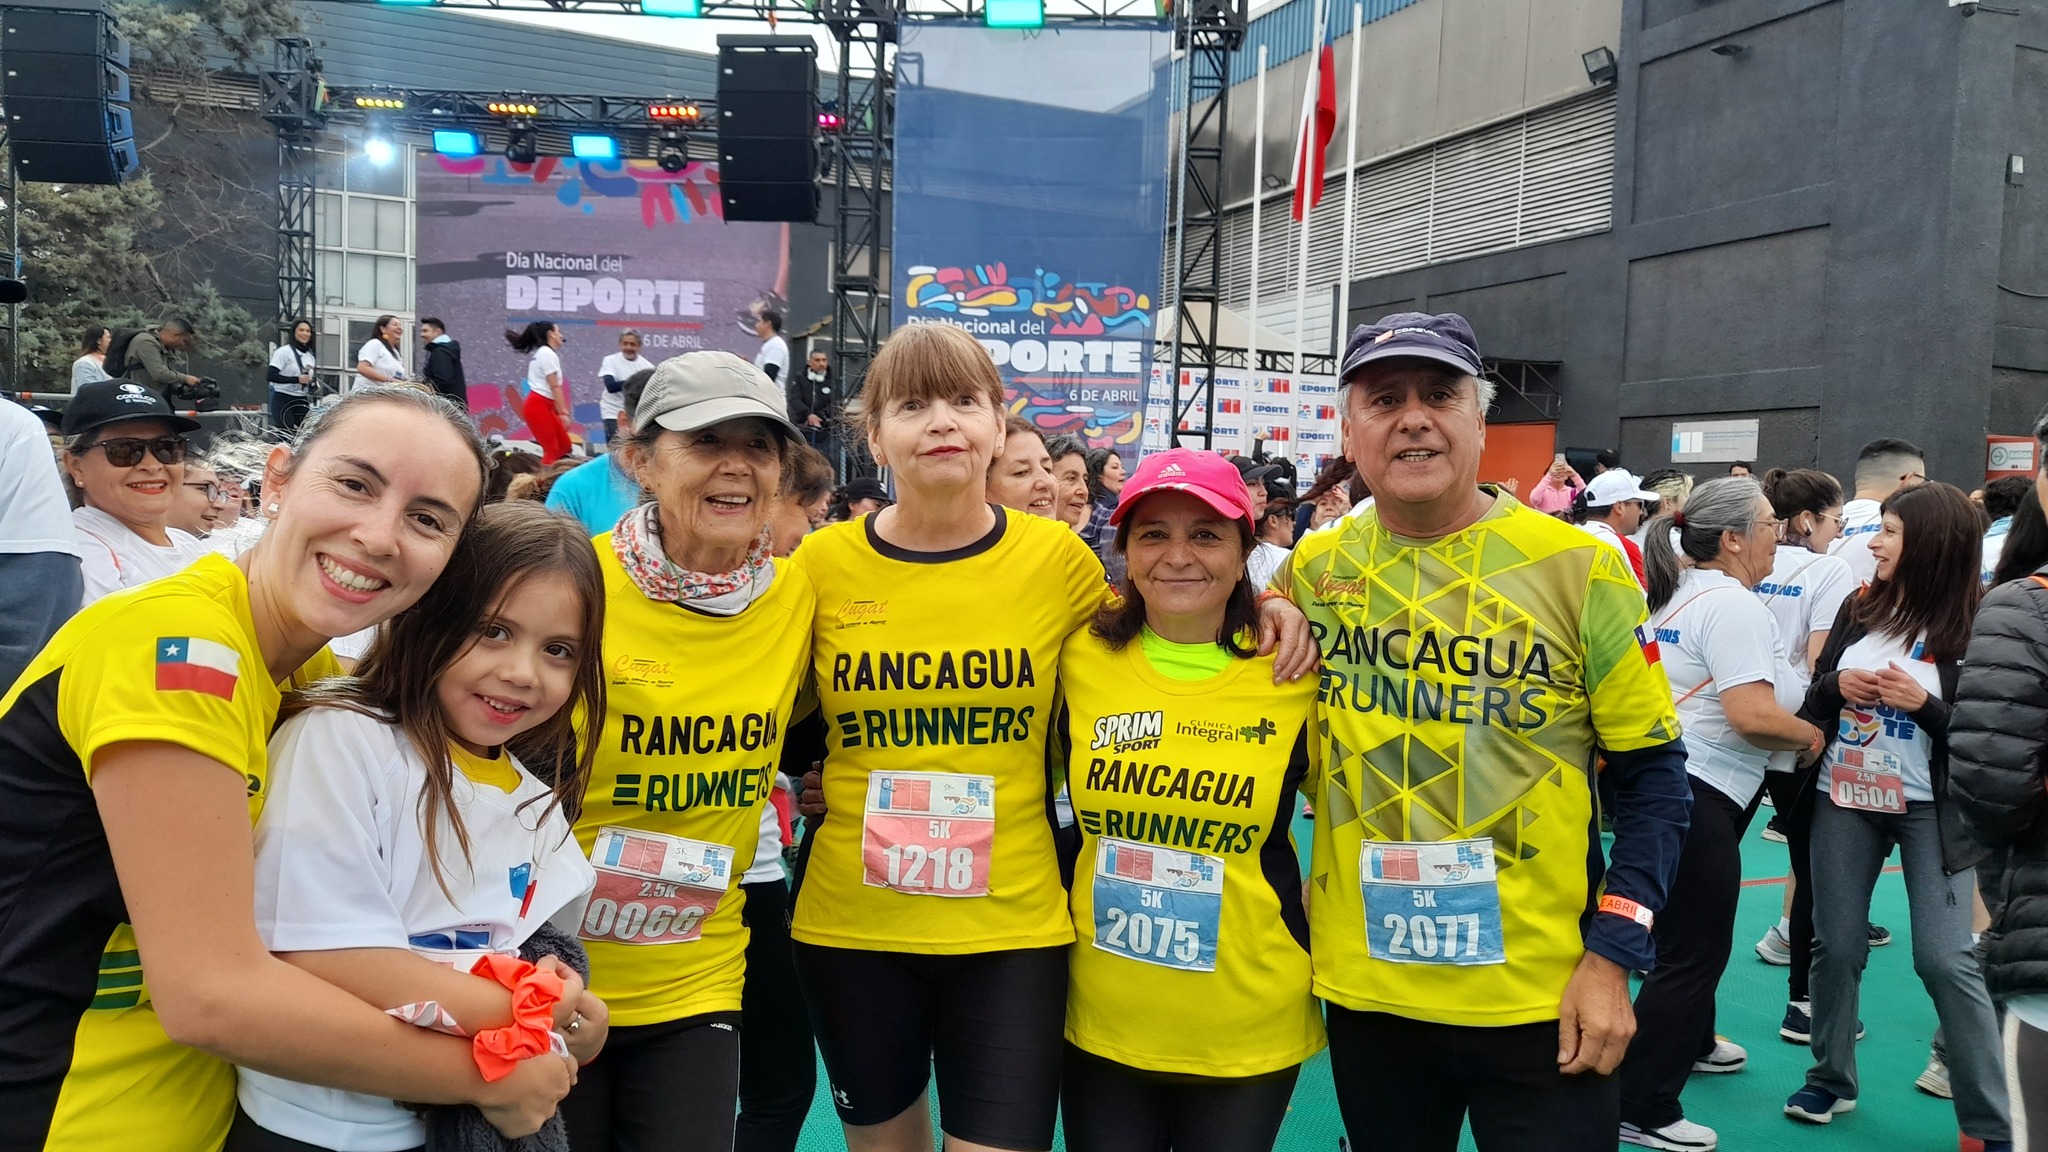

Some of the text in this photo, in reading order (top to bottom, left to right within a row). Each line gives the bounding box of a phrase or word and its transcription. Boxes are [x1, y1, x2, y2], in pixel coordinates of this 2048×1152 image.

[506, 251, 623, 272] Día Nacional del
[506, 275, 704, 316] DEPORTE
[1020, 319, 1045, 335] del
[1394, 327, 1441, 338] COPEVAL
[643, 335, 703, 350] 6 DE ABRIL
[977, 339, 1142, 373] PORTE
[1069, 390, 1078, 401] 6
[1081, 390, 1099, 401] DE
[1101, 390, 1139, 402] ABRIL
[1157, 470, 1186, 479] adidas
[833, 648, 1035, 692] RANCAGUA
[1330, 670, 1547, 730] RUNNERS
[620, 709, 778, 756] RANCAGUA
[863, 706, 1035, 748] RUNNERS
[1090, 711, 1163, 751] SPRIM
[1176, 722, 1239, 743] Integral
[1190, 719, 1232, 730] CLÍNICA
[1883, 717, 1916, 740] TE
[1113, 738, 1161, 755] SPORT
[645, 761, 772, 812] RUNNERS
[1086, 757, 1255, 809] RANCAGUA
[1838, 780, 1901, 810] 0504
[928, 820, 951, 839] 5K
[1105, 808, 1260, 853] RUNNERS
[703, 857, 726, 869] POR
[713, 867, 725, 877] TE
[883, 843, 974, 891] 1218
[1140, 888, 1163, 909] 5K
[1412, 889, 1437, 908] 5K
[1606, 899, 1637, 916] ABRIL
[584, 898, 704, 941] 0066
[1105, 907, 1199, 962] 2075
[1383, 912, 1480, 958] 2077
